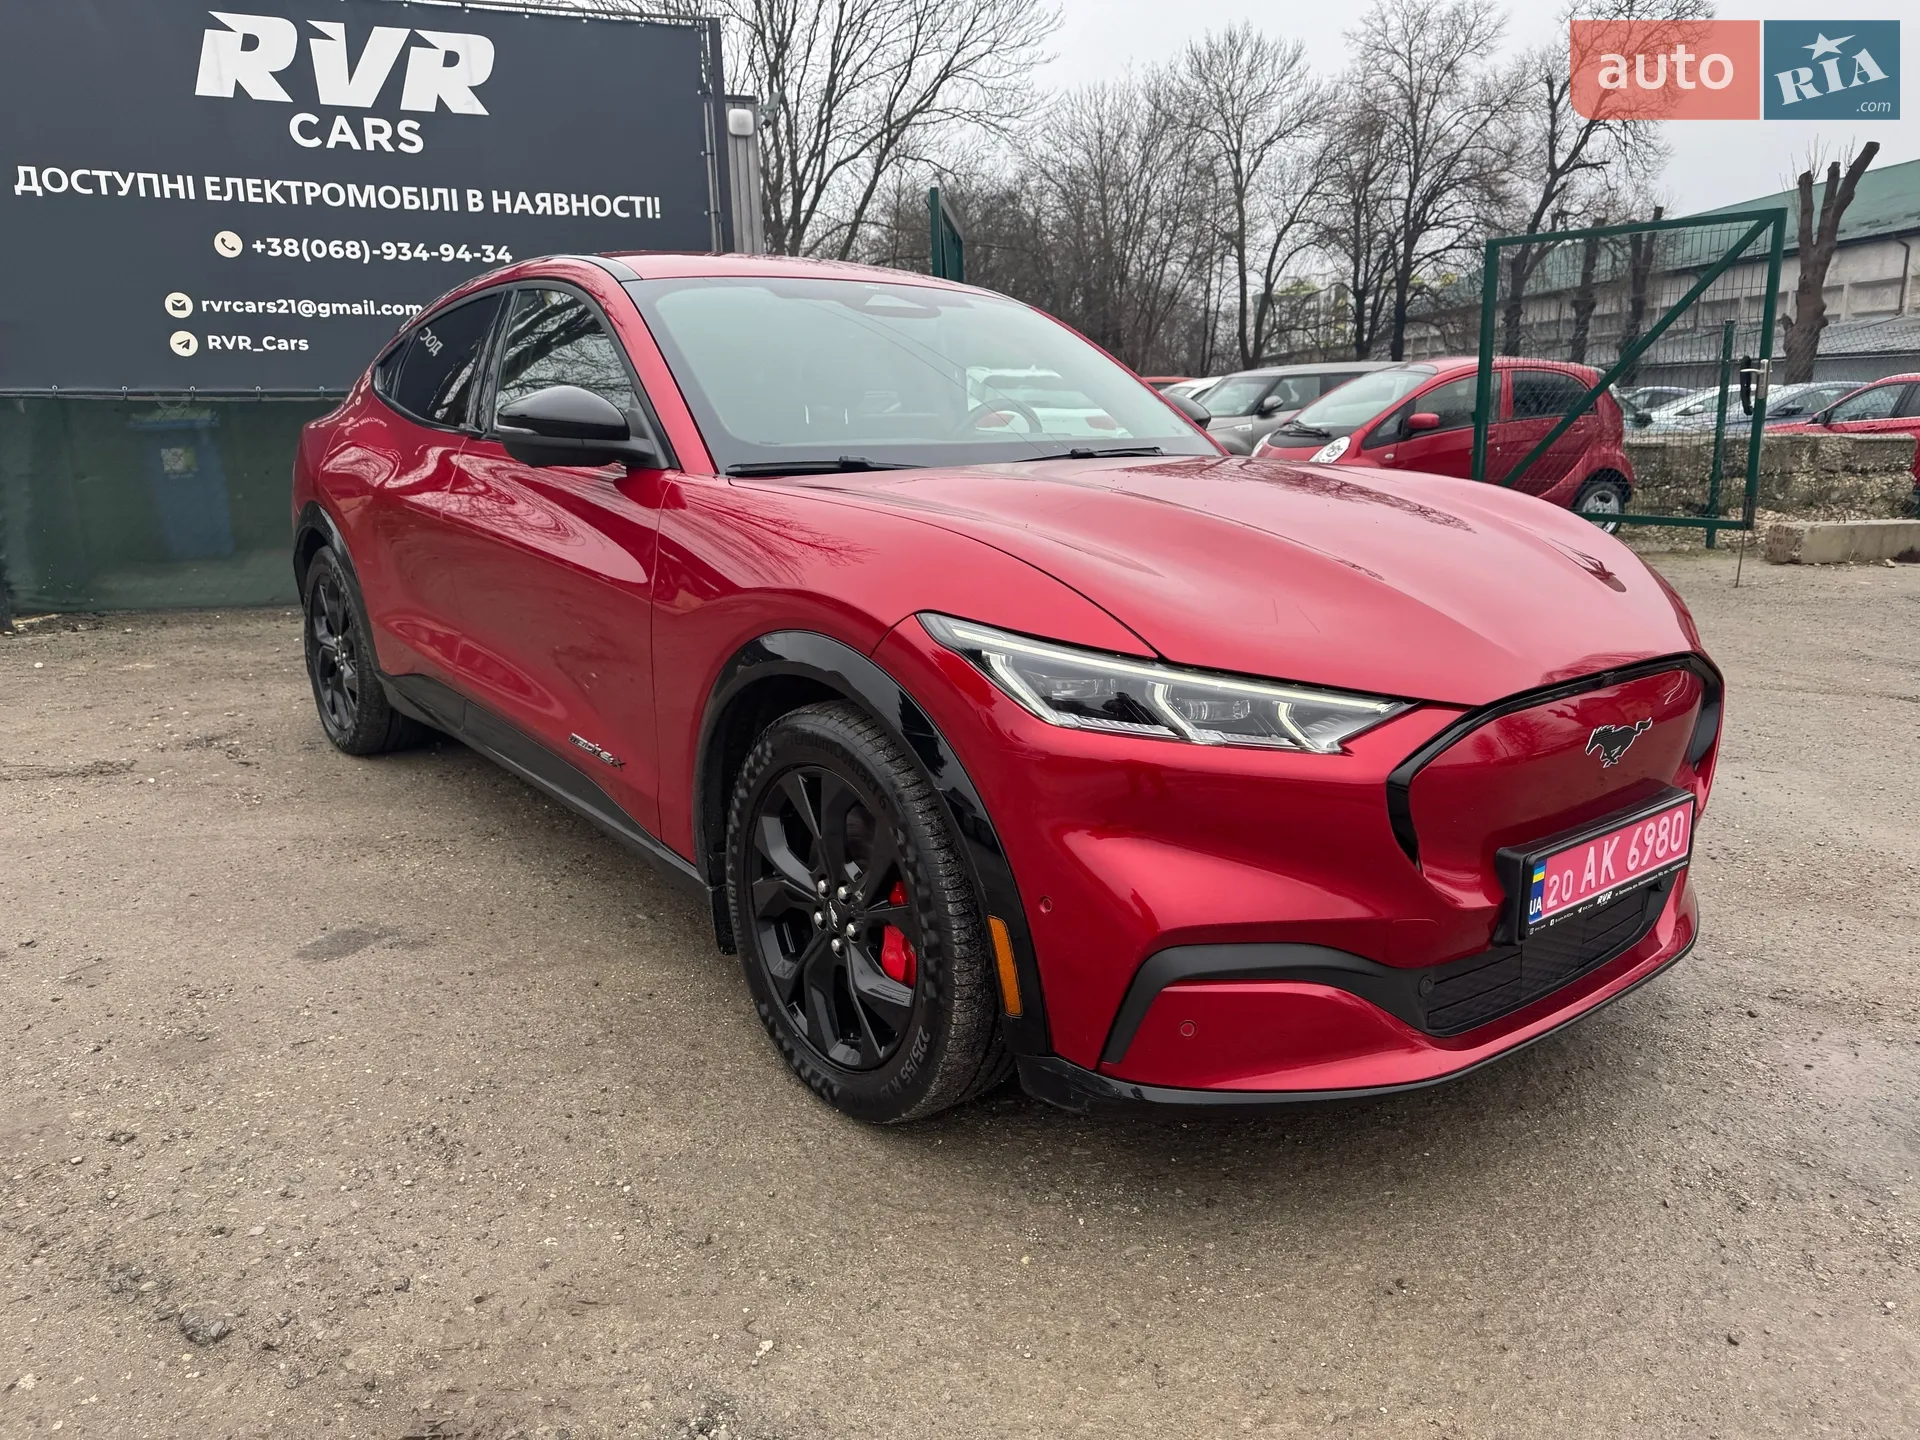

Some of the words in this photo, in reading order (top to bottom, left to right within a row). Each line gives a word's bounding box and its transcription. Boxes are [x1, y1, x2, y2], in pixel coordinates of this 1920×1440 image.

[195, 10, 495, 116] RVR
[289, 112, 424, 154] CARS
[14, 165, 196, 200] ДОСТУПНІ
[204, 176, 459, 212] ЕЛЕКТРОМОБІЛІ
[466, 188, 484, 213] В
[491, 190, 661, 219] НАЯВНОСТІ!
[251, 237, 513, 264] +38(068)-934-94-34
[201, 299, 423, 317] rvrcars21@gmail.com
[207, 335, 310, 352] RVR_Cars
[1546, 869, 1573, 909] 20
[1580, 835, 1620, 893] AK
[1626, 810, 1685, 872] 6980
[1529, 896, 1543, 916] UA
[900, 1024, 931, 1085] 225/55
